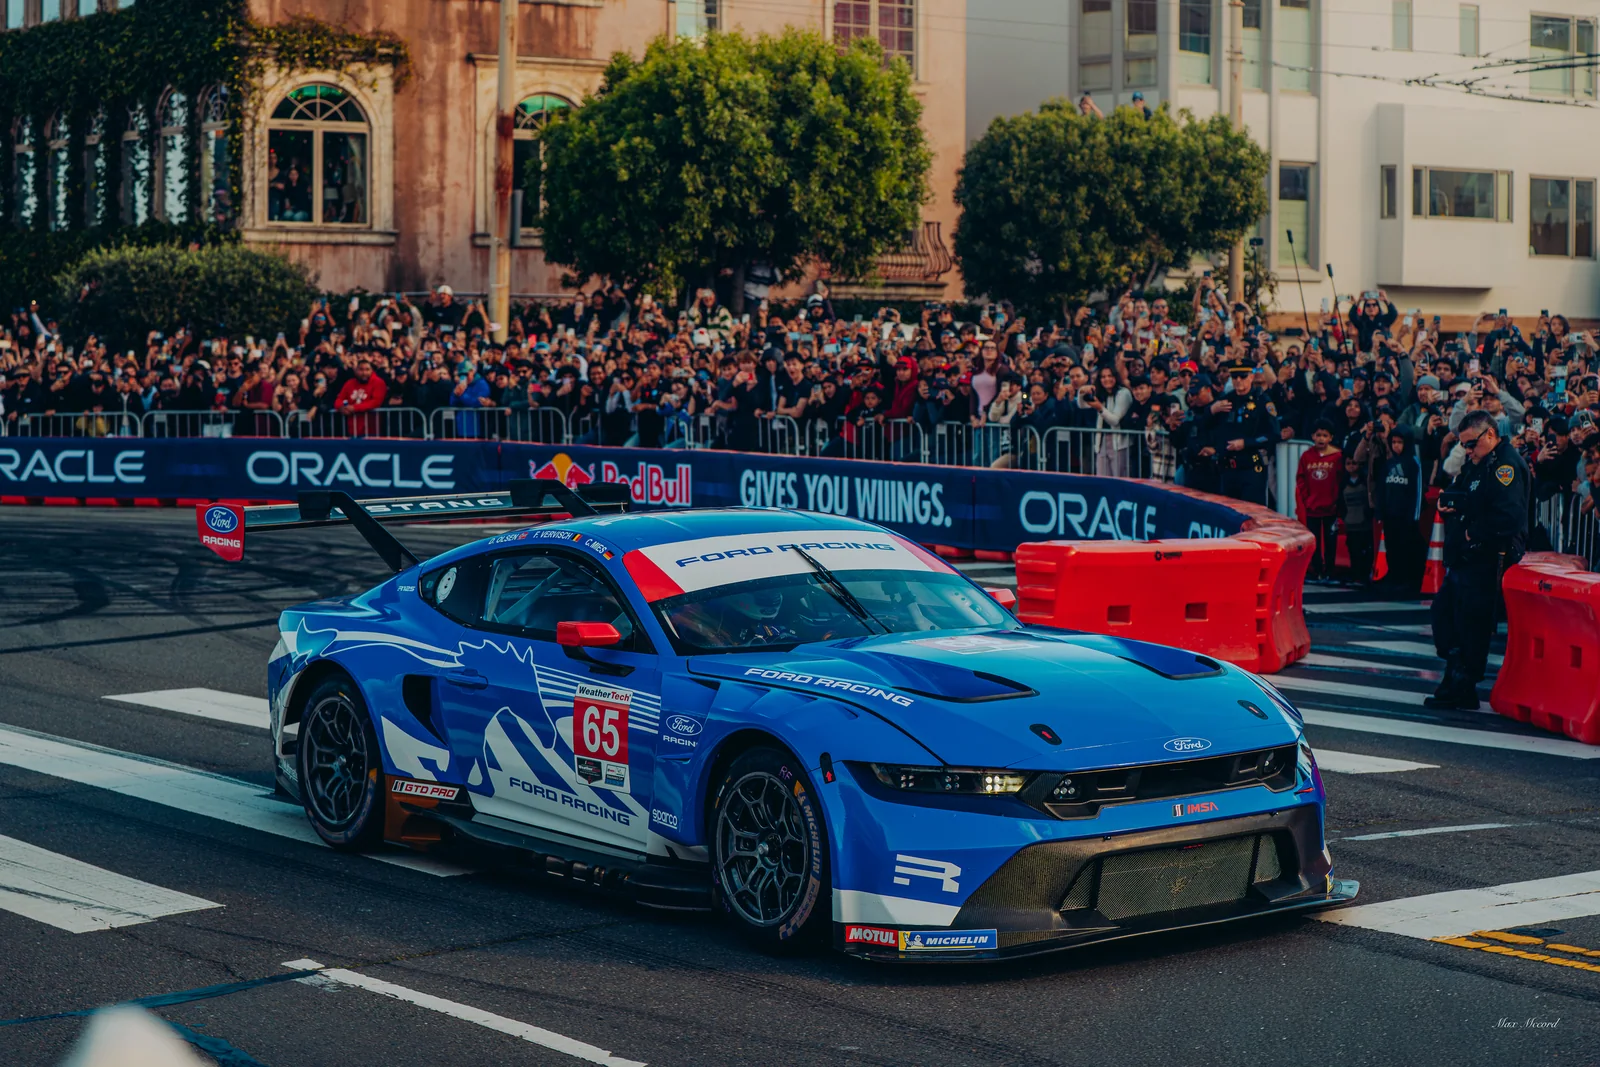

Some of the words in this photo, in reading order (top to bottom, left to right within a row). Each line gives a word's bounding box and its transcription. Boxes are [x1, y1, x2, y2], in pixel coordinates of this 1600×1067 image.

[246, 450, 456, 489] ORACLE
[647, 464, 691, 507] Bull
[1386, 476, 1409, 485] adidas
[740, 469, 799, 508] GIVES
[804, 473, 849, 516] YOU
[855, 477, 952, 528] WIIINGS.
[211, 509, 232, 529] Ford
[1019, 490, 1157, 541] ORACLE
[203, 535, 241, 548] RACING
[496, 533, 519, 544] OLSEN
[533, 531, 540, 539] F.
[540, 531, 574, 540] VERVISCH
[591, 541, 608, 554] MIES
[676, 546, 773, 568] FORD
[777, 541, 896, 552] RACING
[578, 686, 632, 702] WeatherTech
[744, 668, 813, 684] FORD
[814, 678, 914, 707] RACING
[583, 705, 620, 756] 65
[671, 716, 695, 734] Ford
[663, 735, 698, 748] RACIN
[1173, 739, 1204, 751] Ford
[404, 784, 429, 794] GTD
[430, 788, 457, 798] PRO
[509, 777, 558, 802] FORD
[561, 794, 630, 826] RACING
[1187, 802, 1219, 814] IMSA
[652, 808, 678, 827] sparco
[803, 805, 821, 874] MICHELIN
[849, 927, 896, 944] MOTUL
[926, 935, 989, 945] MICHELIN
